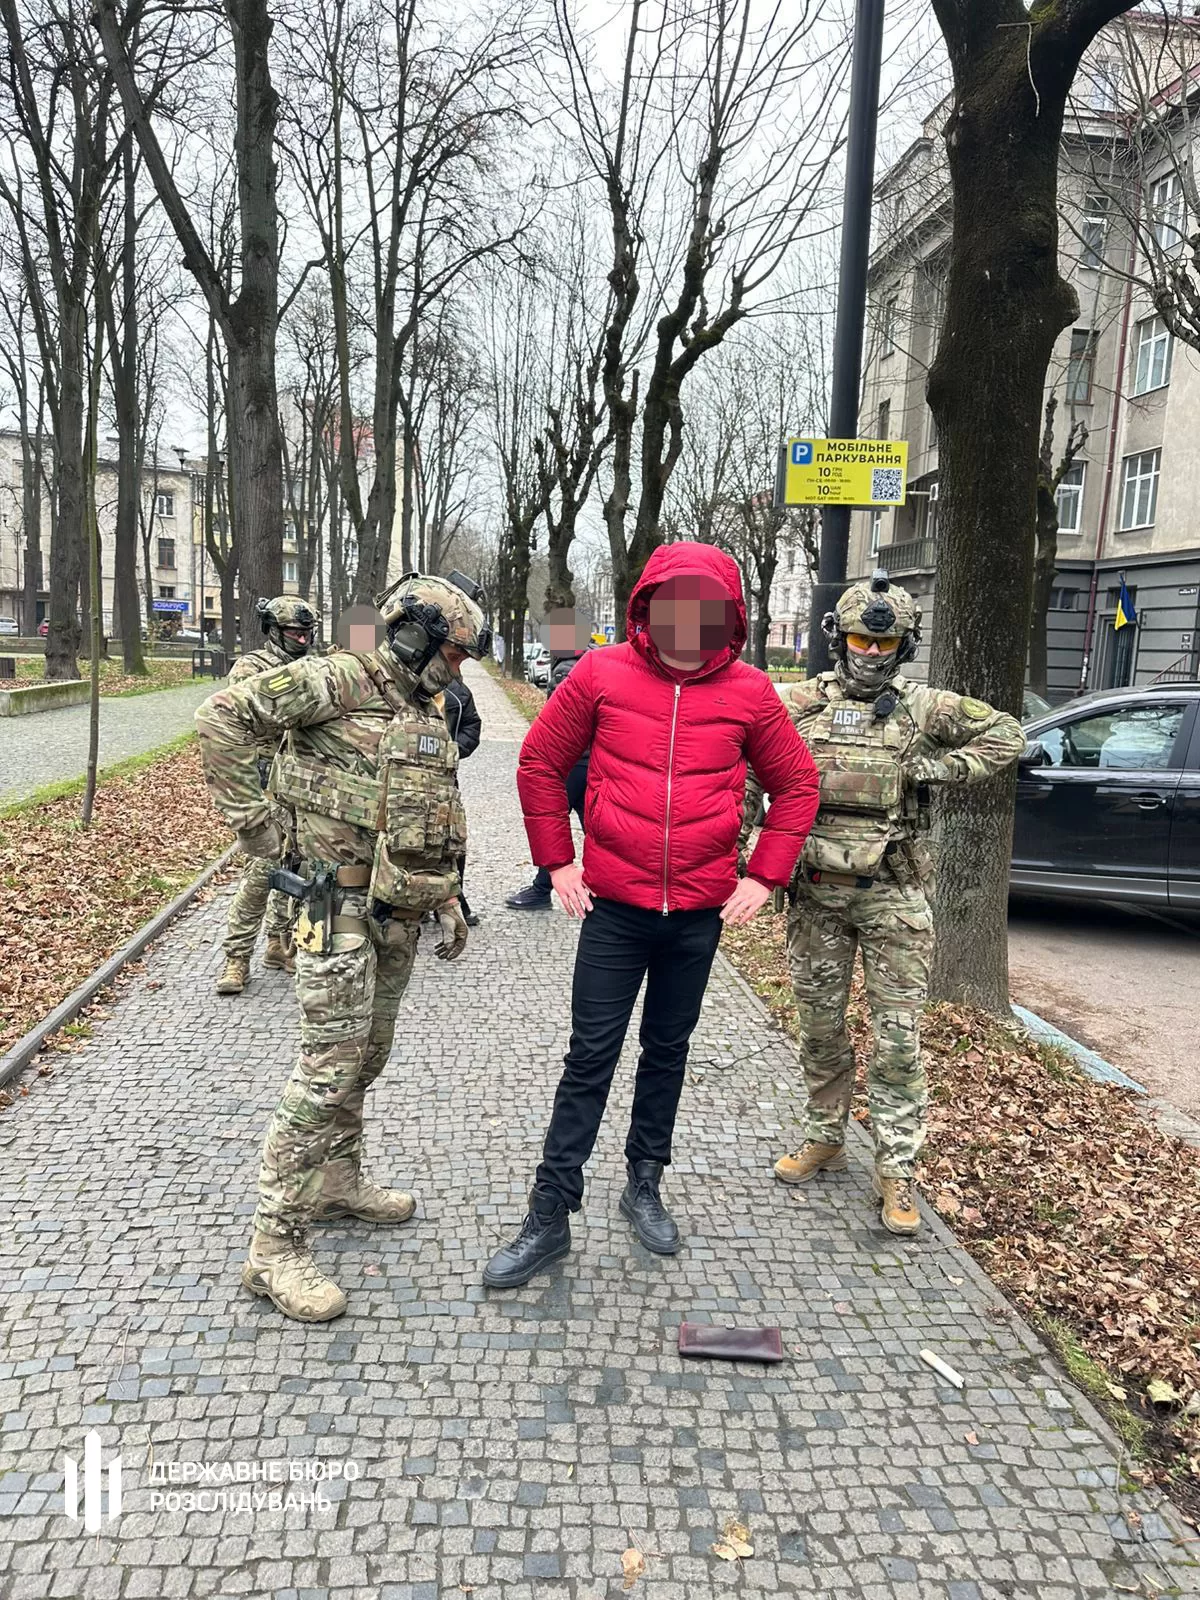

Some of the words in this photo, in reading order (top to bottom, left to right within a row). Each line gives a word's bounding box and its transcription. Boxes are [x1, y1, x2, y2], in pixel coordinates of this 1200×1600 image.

[827, 442, 892, 453] МОБІЛЬНЕ
[816, 453, 901, 464] ПАРКУВАННЯ
[818, 467, 831, 477] 10
[817, 485, 830, 495] 10
[833, 710, 861, 725] ДБР
[419, 735, 440, 755] ДБР
